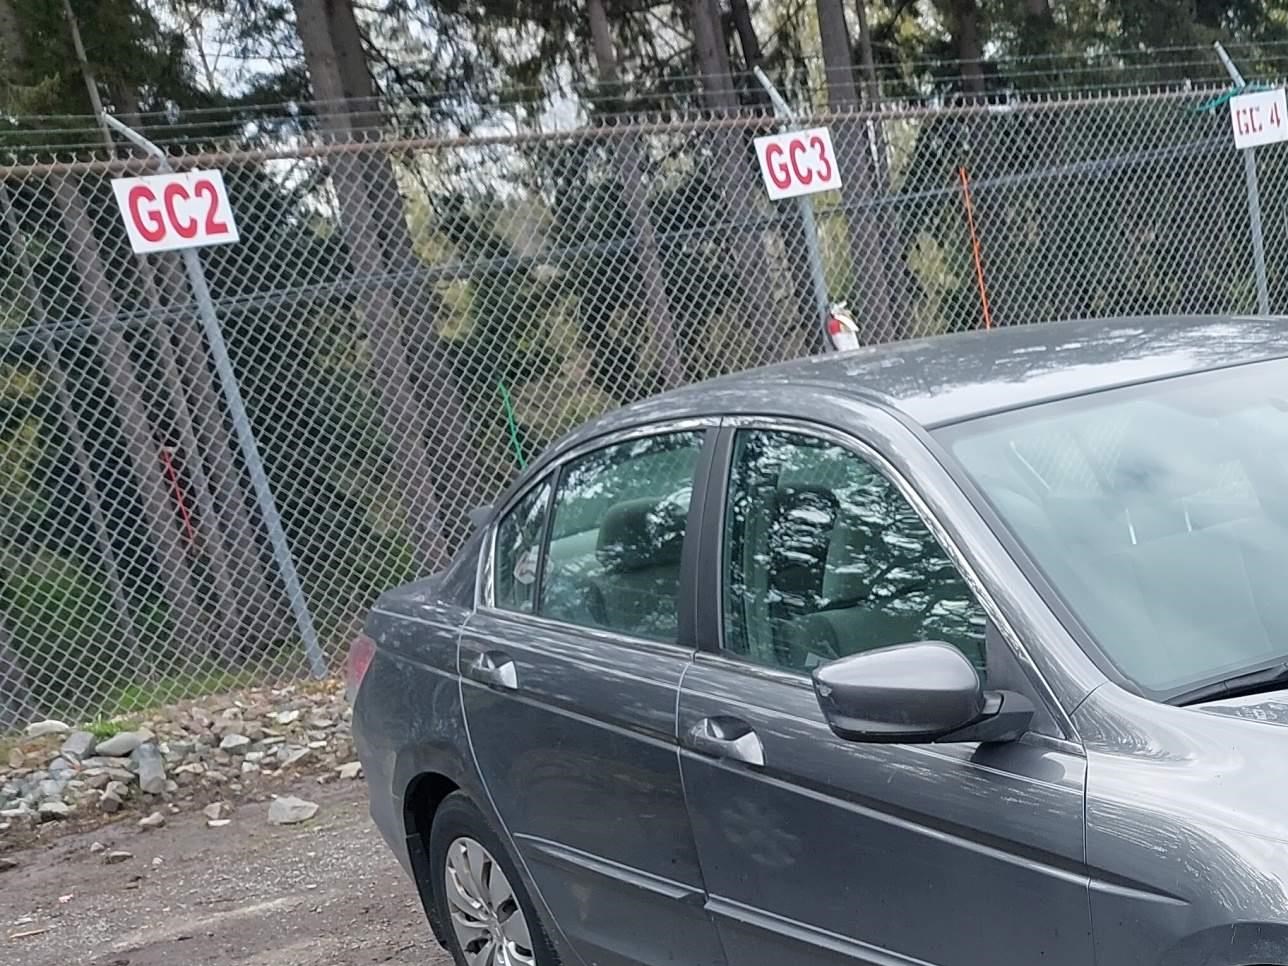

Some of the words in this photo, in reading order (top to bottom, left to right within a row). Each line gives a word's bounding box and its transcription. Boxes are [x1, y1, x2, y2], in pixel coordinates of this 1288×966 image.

[1236, 106, 1263, 136] GC
[1269, 101, 1281, 129] 4
[765, 135, 832, 190] GC3
[128, 179, 229, 243] GC2
